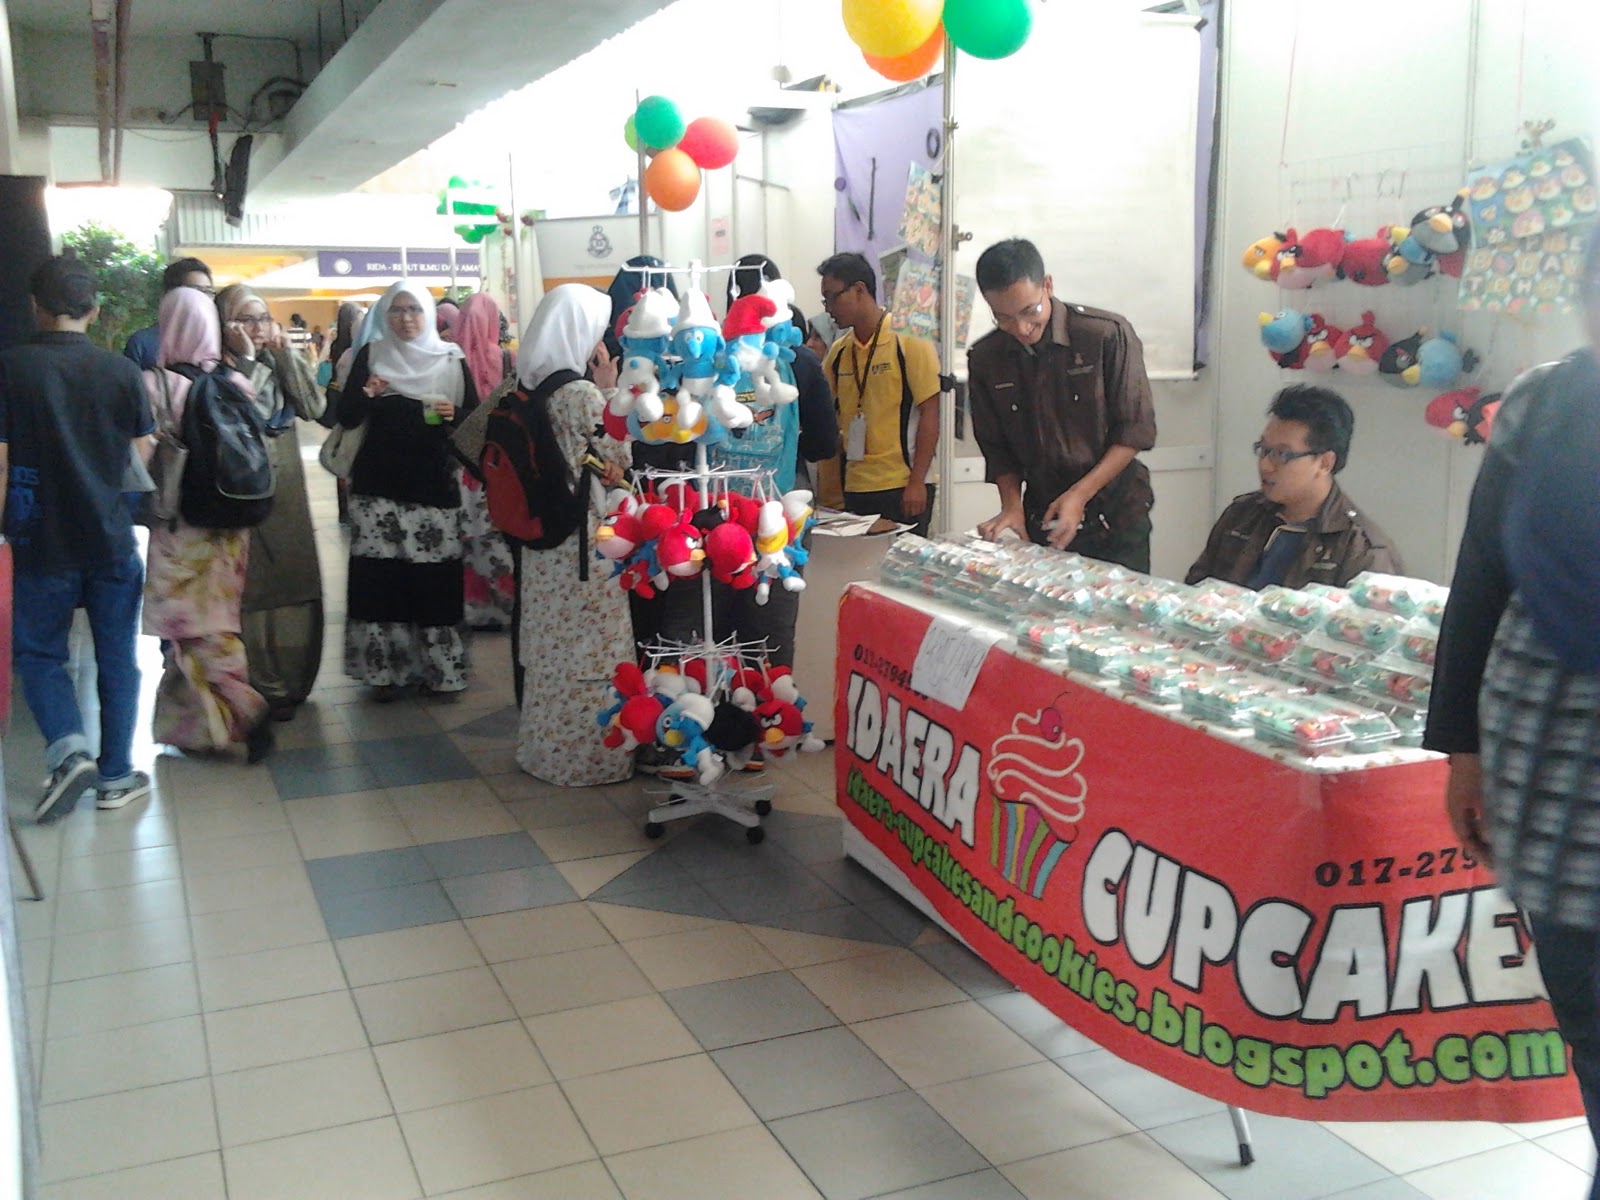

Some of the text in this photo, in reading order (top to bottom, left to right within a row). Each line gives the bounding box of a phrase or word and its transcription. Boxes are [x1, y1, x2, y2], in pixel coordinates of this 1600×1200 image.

[393, 262, 418, 271] REUT
[846, 669, 981, 848] IDAERA
[1081, 827, 1552, 1024] CUPCAKE
